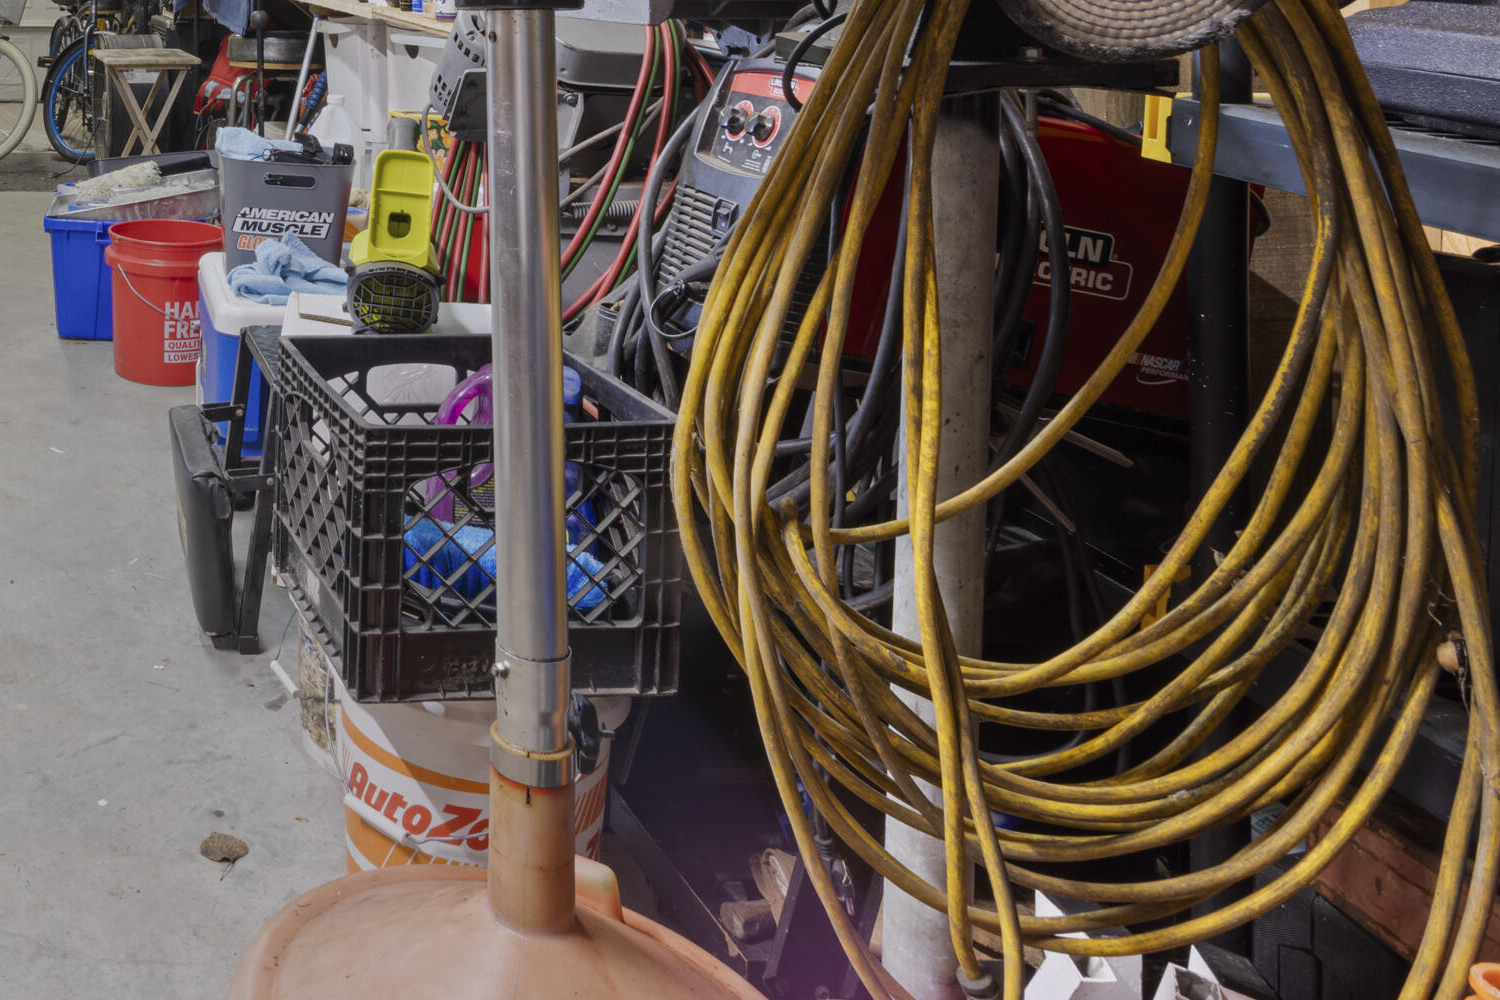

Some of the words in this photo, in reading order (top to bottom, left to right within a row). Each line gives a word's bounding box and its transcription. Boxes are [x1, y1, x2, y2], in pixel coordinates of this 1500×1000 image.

[237, 207, 335, 224] AMERICAN
[240, 220, 325, 236] MUSCLE
[168, 352, 200, 362] LOWES
[1140, 354, 1182, 371] NASCAR
[1140, 367, 1189, 381] PERFORMAN
[349, 761, 489, 851] AutoZo
